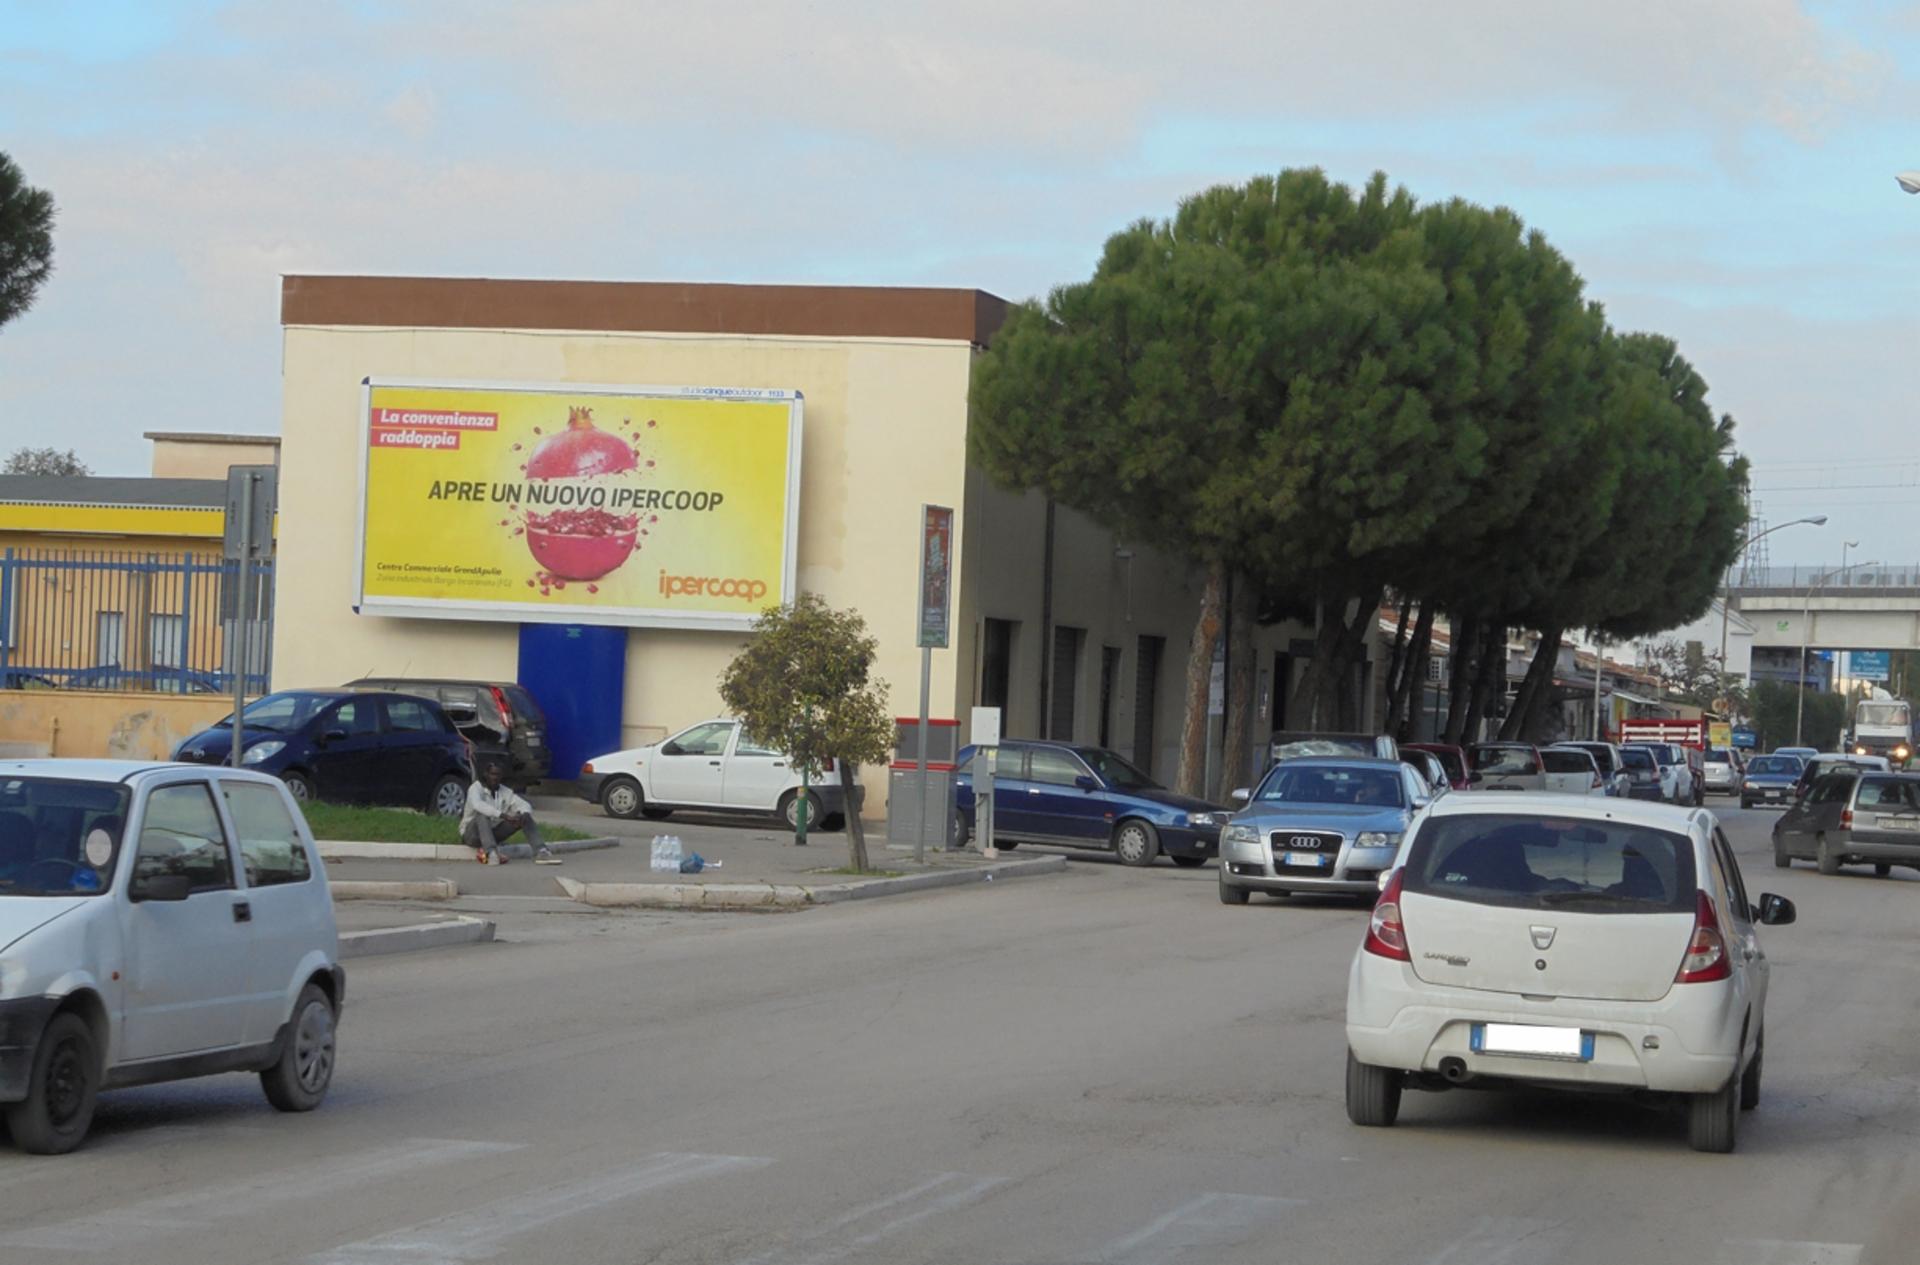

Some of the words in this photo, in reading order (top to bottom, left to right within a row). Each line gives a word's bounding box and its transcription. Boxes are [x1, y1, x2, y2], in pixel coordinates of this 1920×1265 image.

[380, 409, 399, 423] La
[402, 412, 495, 427] convenienza
[379, 430, 457, 448] raddoppia
[427, 480, 487, 501] APRE
[491, 483, 522, 503] UN
[526, 484, 606, 507] NUOVO
[611, 488, 724, 512] IPERCOOP
[376, 562, 402, 571] Centro
[404, 563, 452, 573] Commerciale
[659, 568, 767, 603] ipercoop
